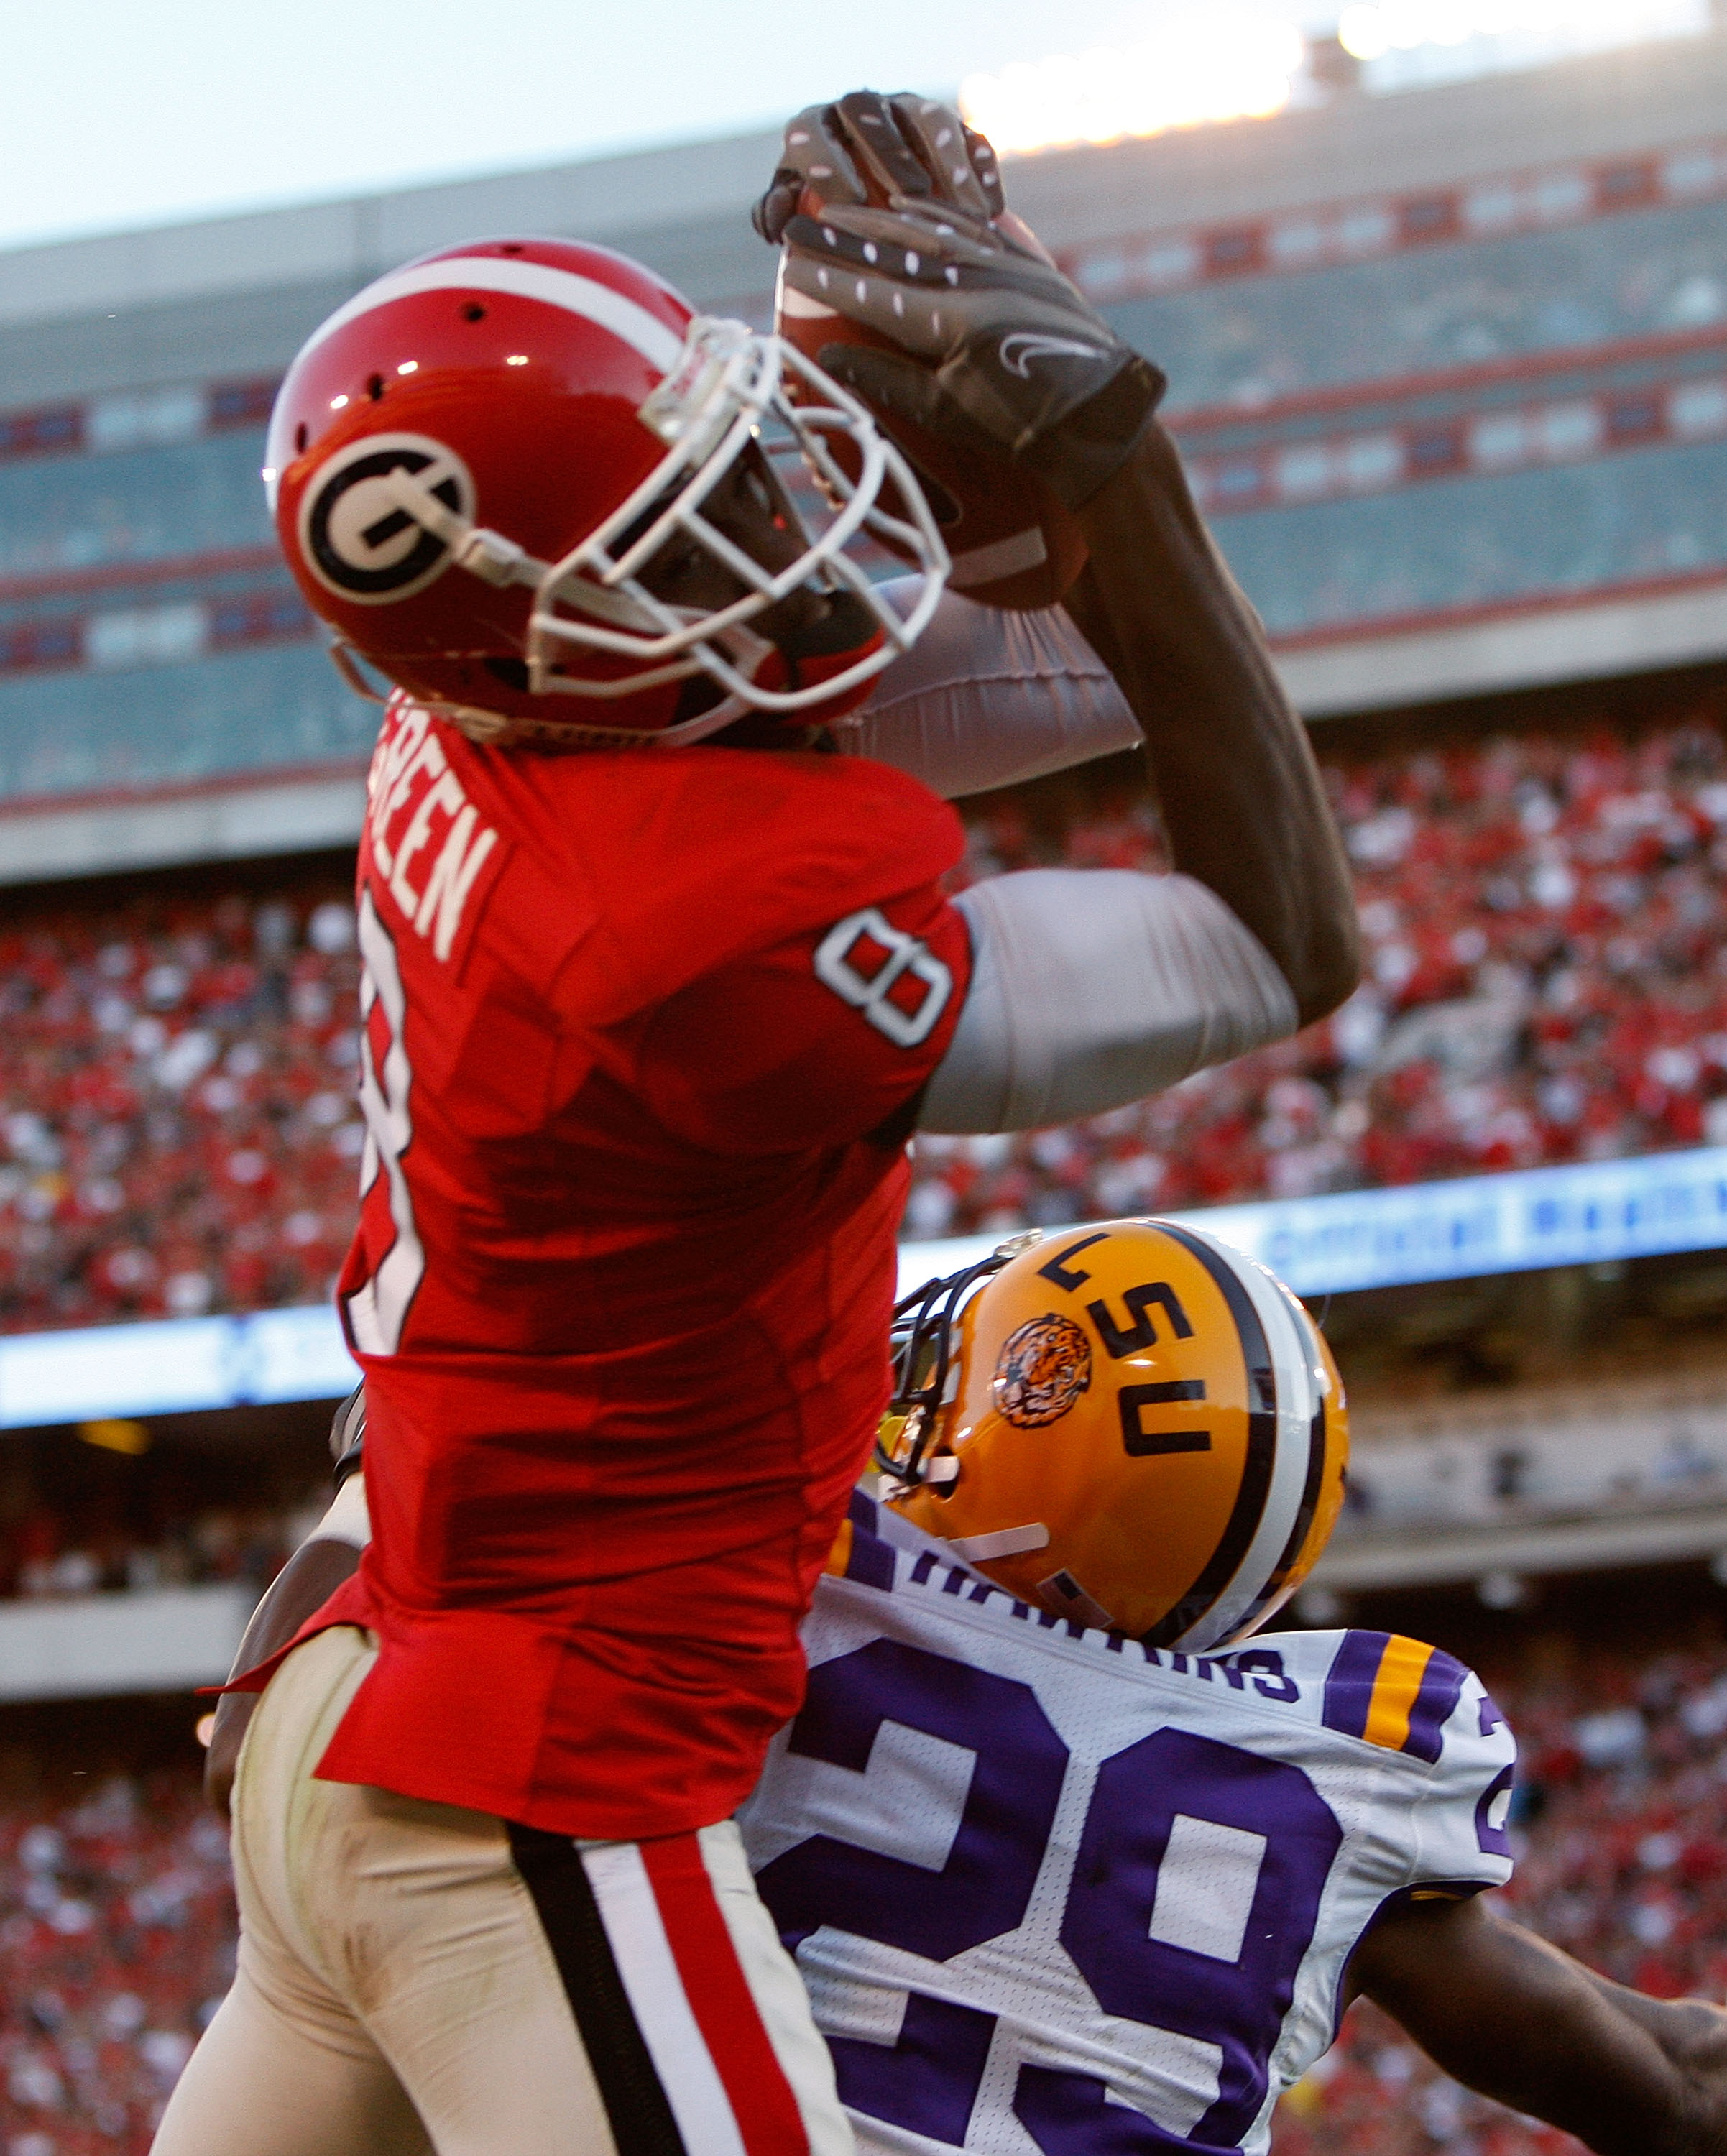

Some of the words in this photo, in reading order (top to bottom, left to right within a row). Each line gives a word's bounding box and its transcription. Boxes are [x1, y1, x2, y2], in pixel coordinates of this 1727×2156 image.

[813, 906, 953, 1047] 8
[1037, 1232, 1212, 1457] LSU
[753, 1636, 1343, 2156] 29
